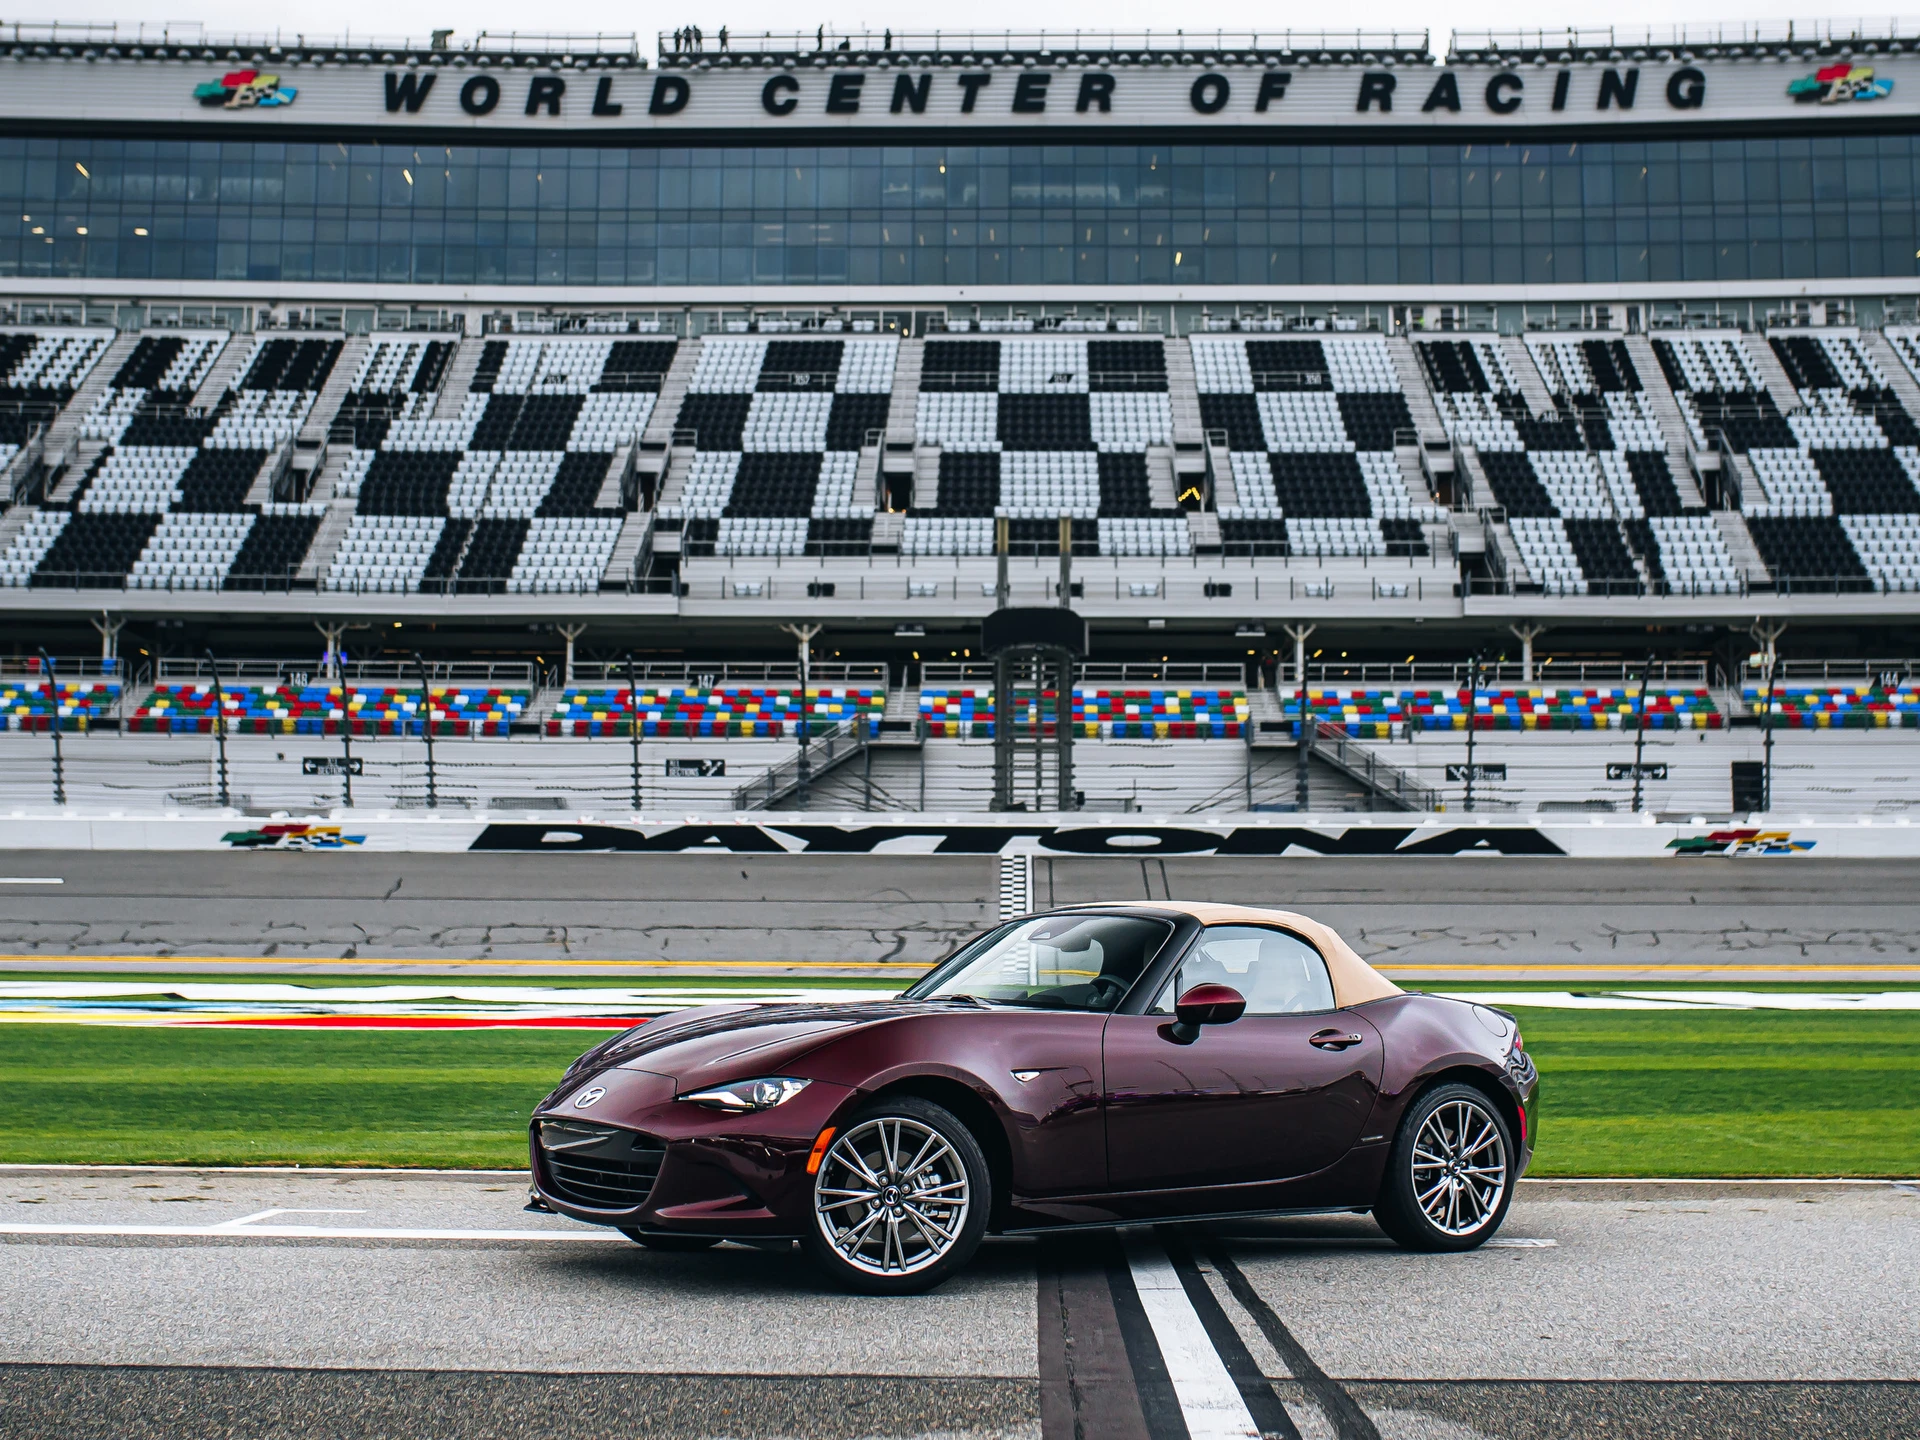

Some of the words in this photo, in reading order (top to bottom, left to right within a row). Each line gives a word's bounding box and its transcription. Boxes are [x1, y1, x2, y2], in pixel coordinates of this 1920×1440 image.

[384, 73, 691, 116] WORLD
[761, 73, 1116, 116] CENTER
[1189, 72, 1292, 115] OF
[1356, 67, 1706, 114] RACING
[290, 672, 308, 687] 148
[698, 674, 714, 689] 147
[1467, 675, 1485, 690] 15
[1880, 671, 1898, 688] 144
[669, 768, 699, 776] SECTIONS
[468, 824, 1568, 855] DAYTONA
